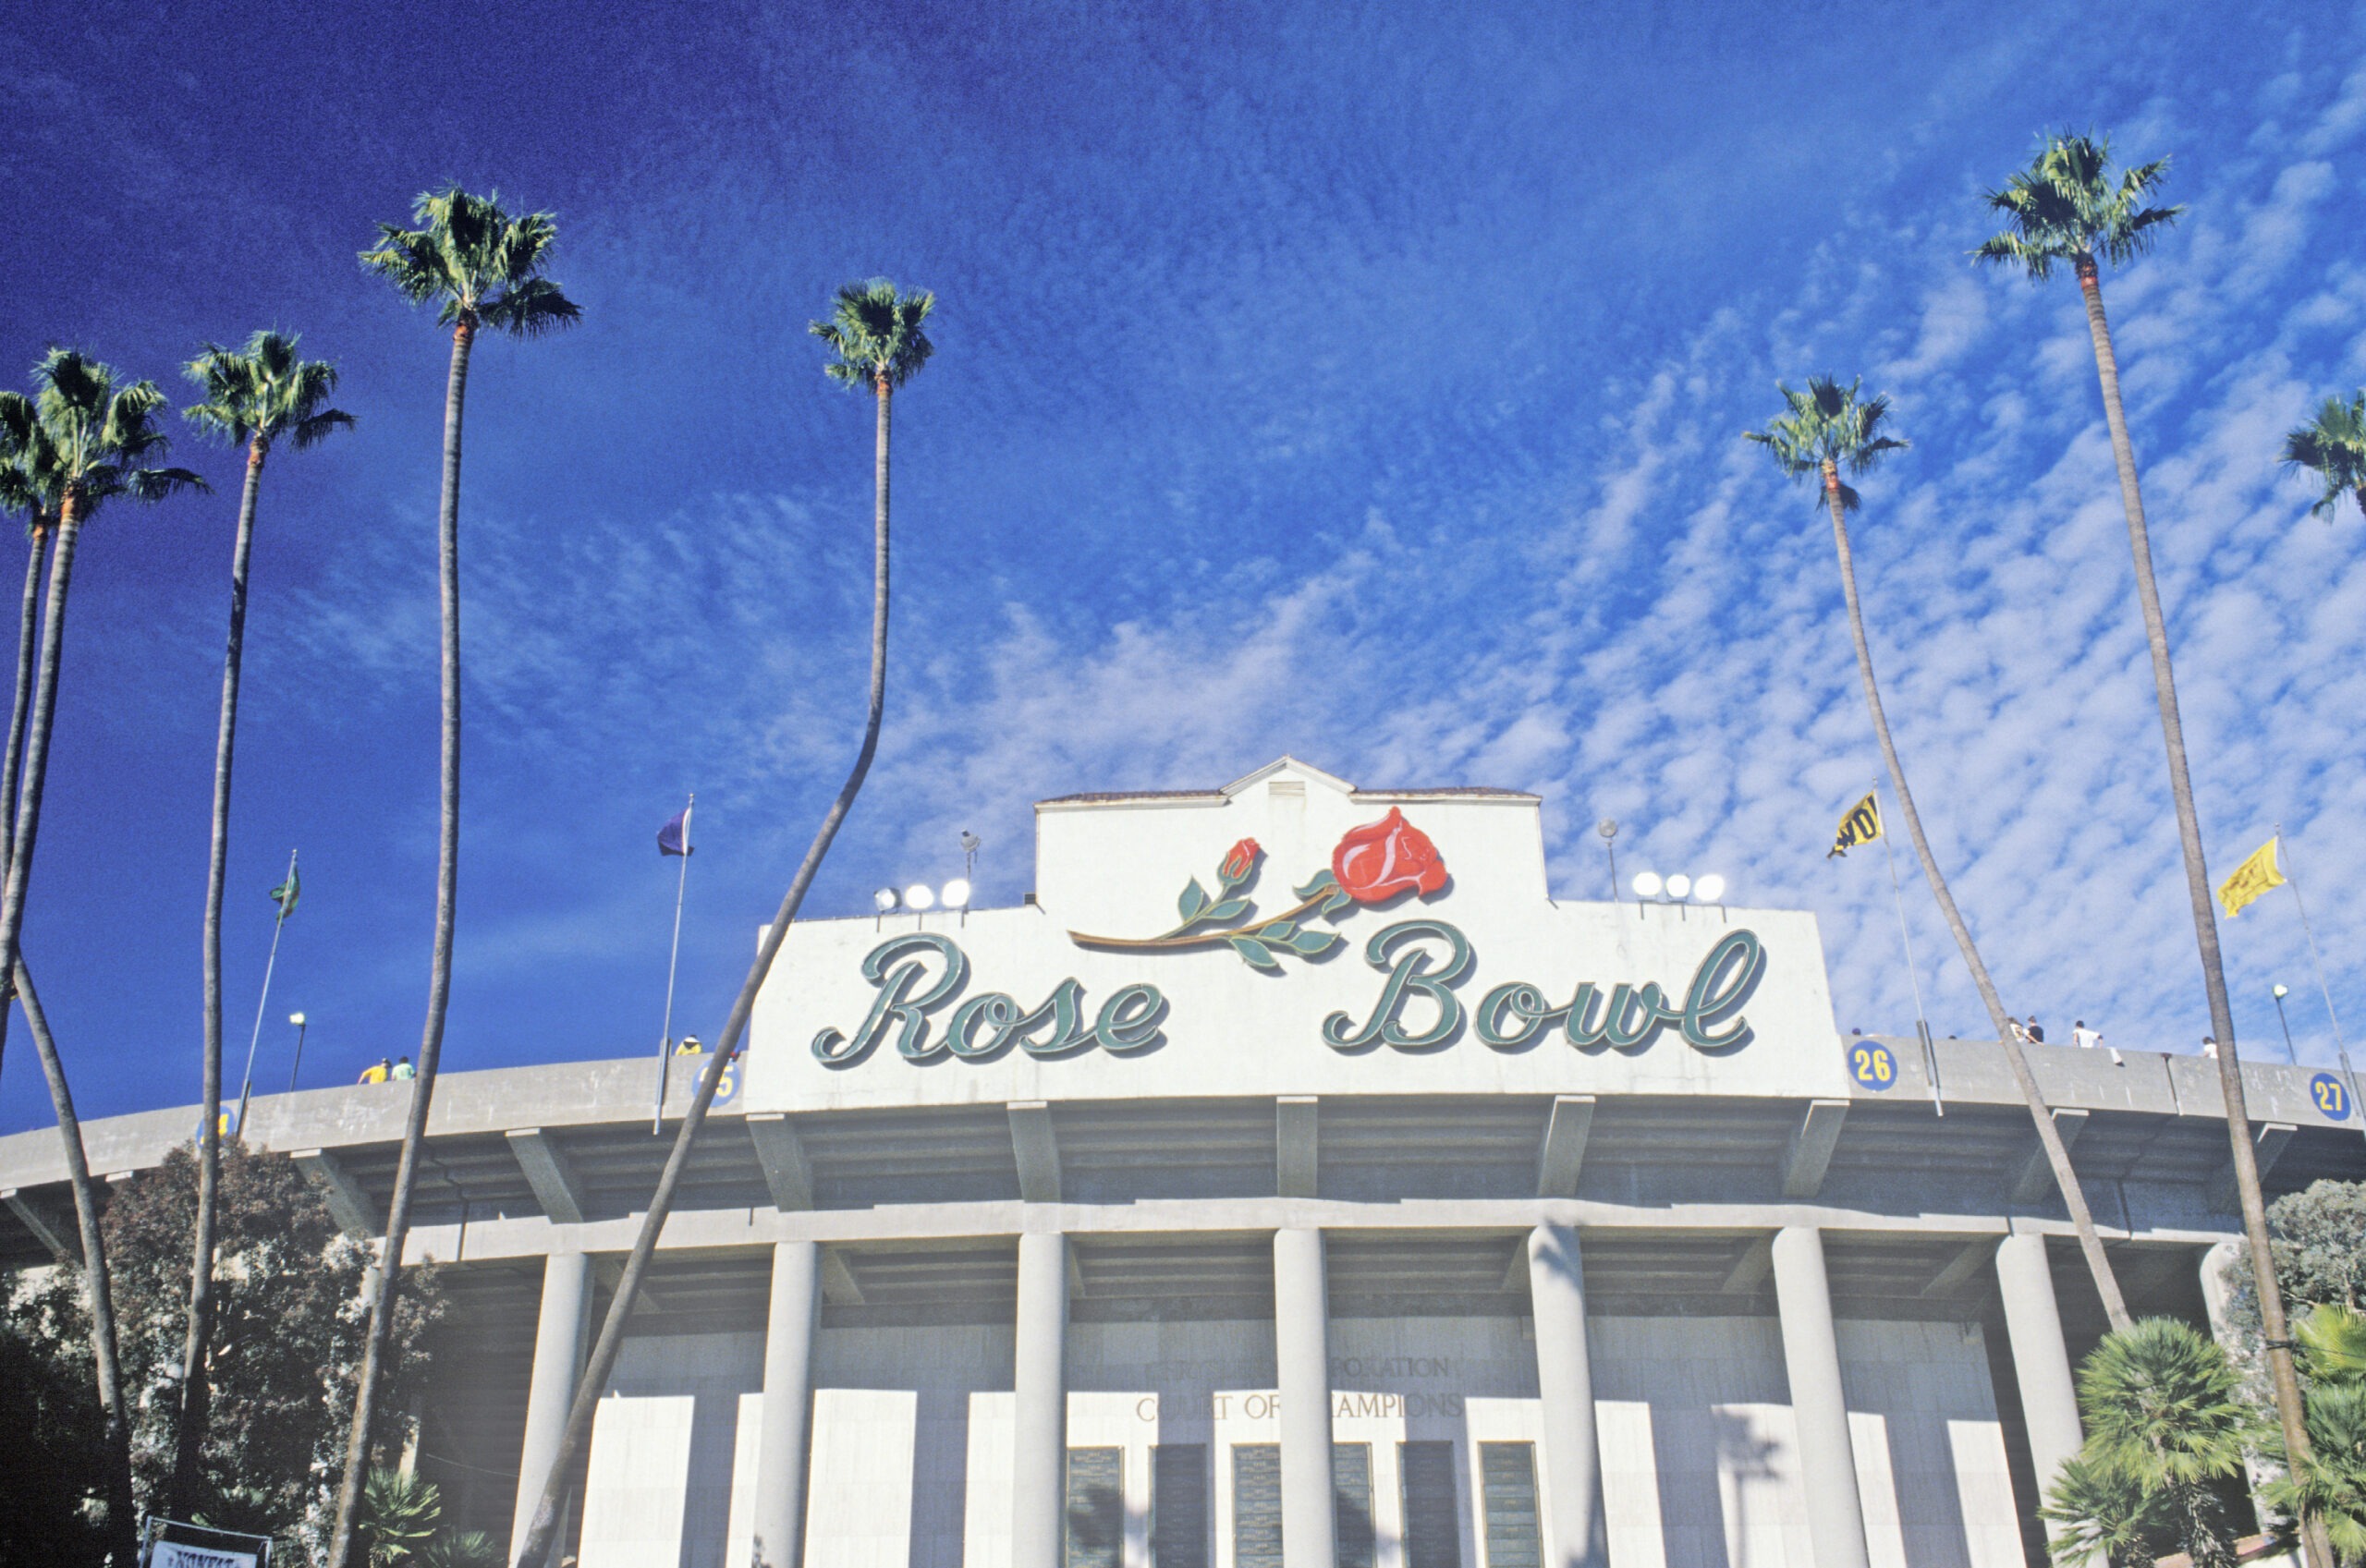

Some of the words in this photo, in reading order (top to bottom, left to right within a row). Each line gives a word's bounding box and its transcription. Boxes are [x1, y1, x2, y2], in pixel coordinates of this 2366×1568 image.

[811, 931, 1162, 1063] Rose
[1322, 919, 1760, 1048] Bowl
[1855, 1050, 1891, 1081] 26
[699, 1065, 734, 1098] 5
[2315, 1081, 2342, 1112] 27
[1136, 1394, 1233, 1422] COURT
[1244, 1393, 1280, 1420] OF
[1331, 1392, 1463, 1419] AMPIONS
